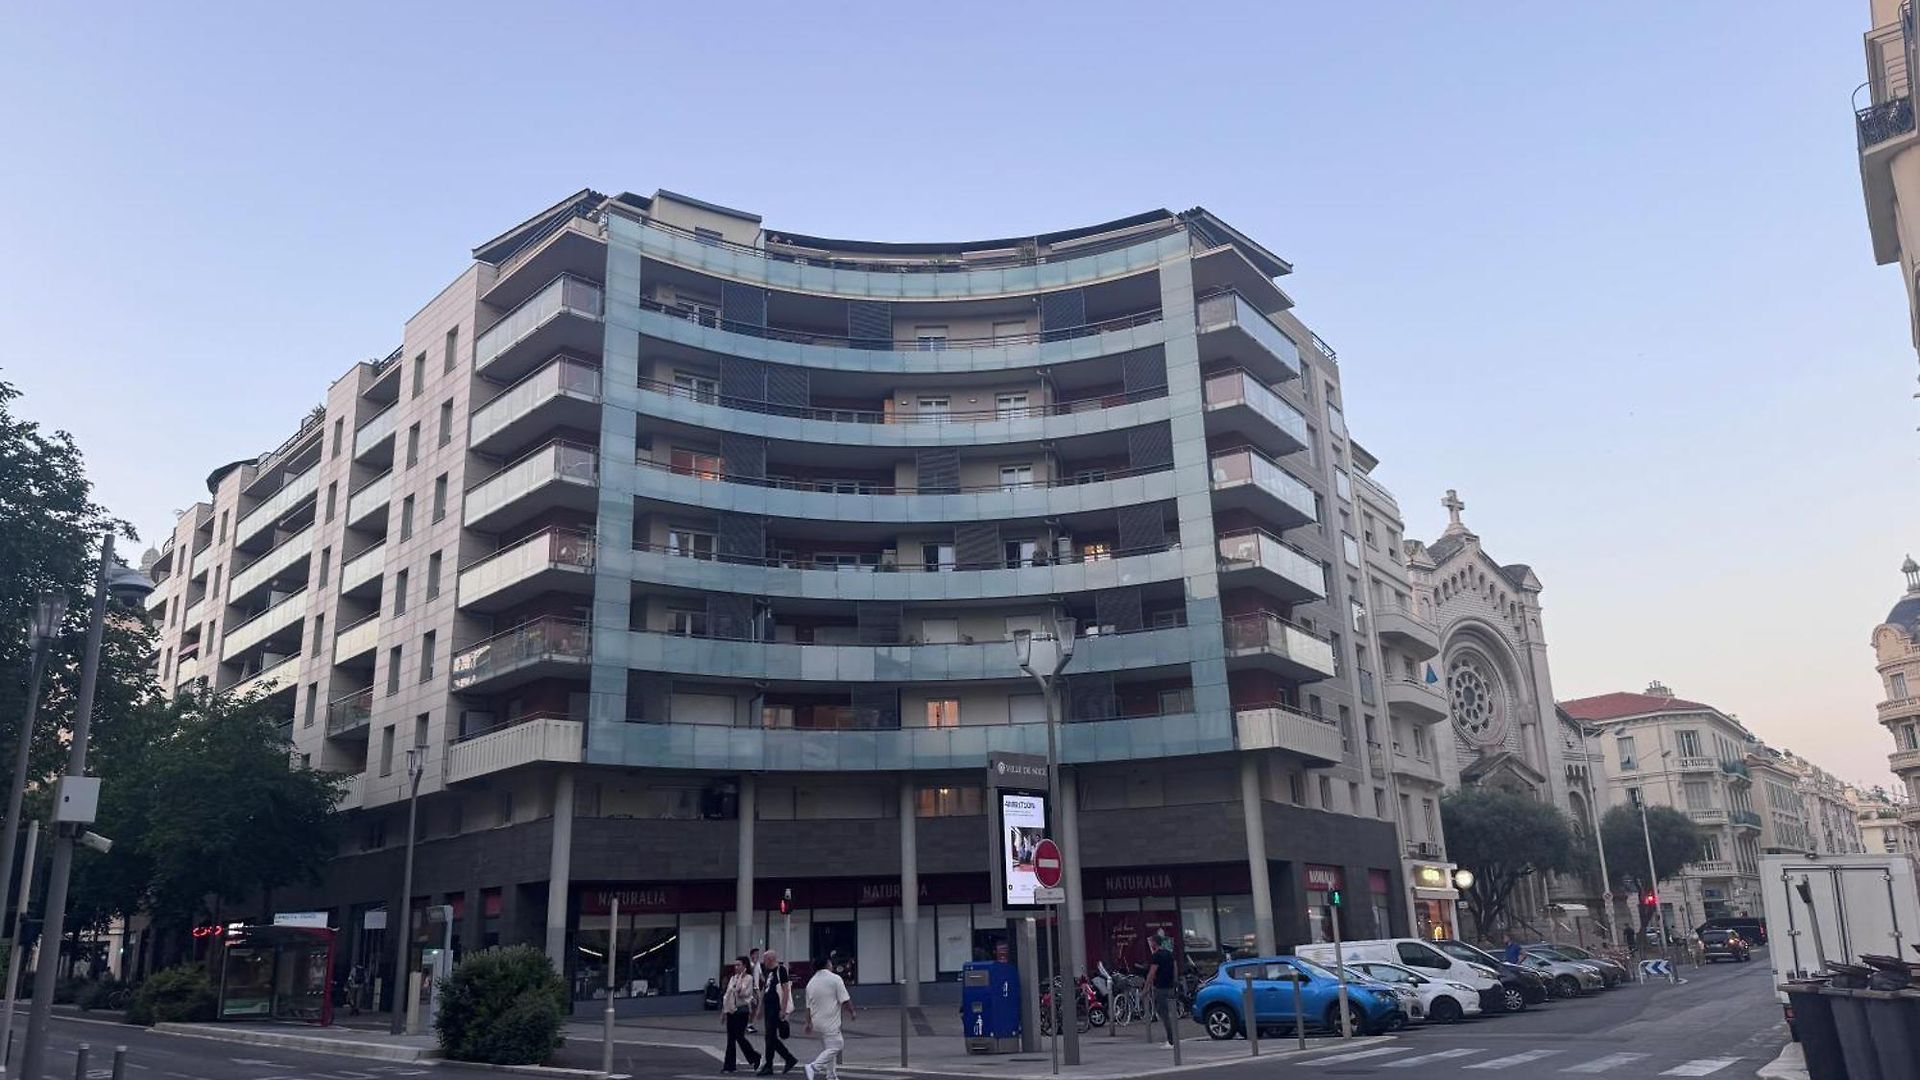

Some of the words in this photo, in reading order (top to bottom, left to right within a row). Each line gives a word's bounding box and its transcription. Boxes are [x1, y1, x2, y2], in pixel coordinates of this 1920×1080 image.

[1105, 874, 1172, 890] NATURALIA
[597, 890, 667, 906] NATURALIA
[863, 883, 928, 898] NATURA
